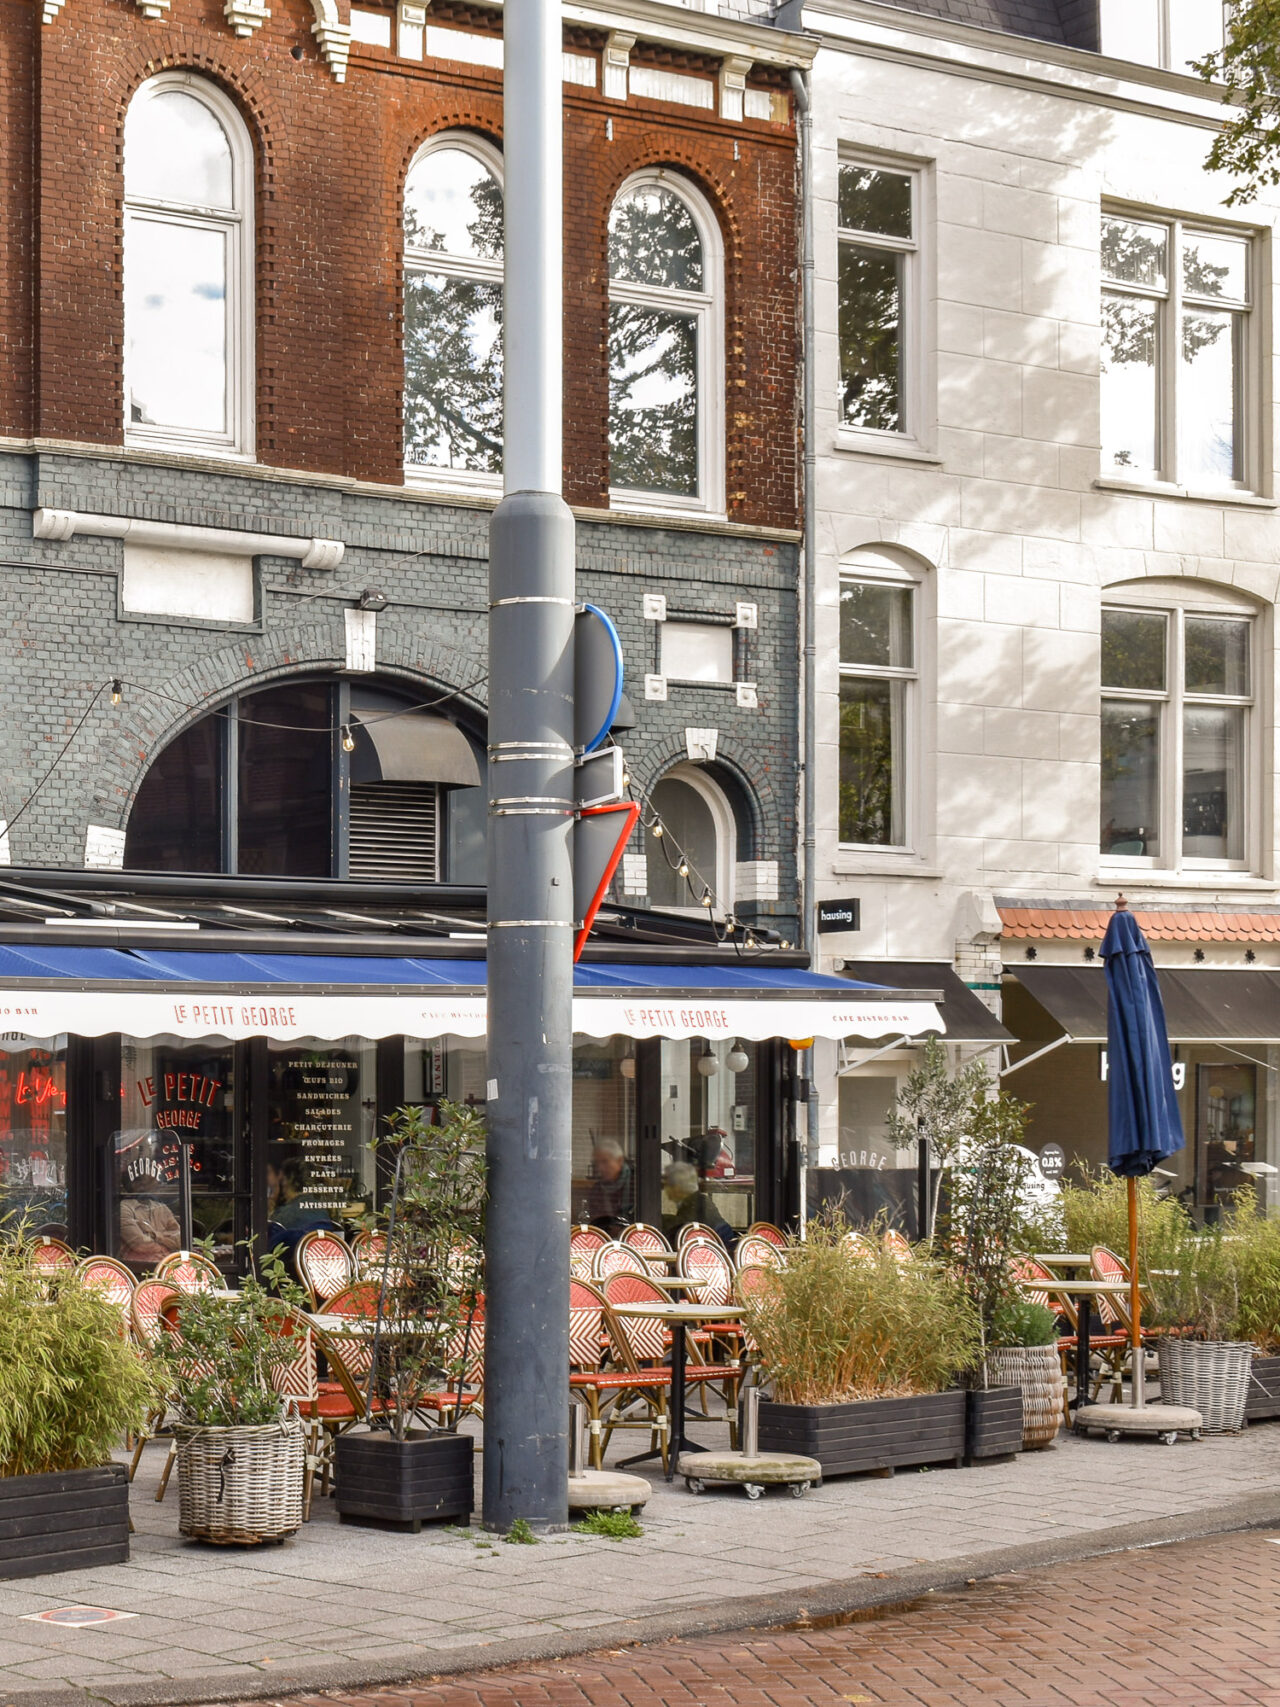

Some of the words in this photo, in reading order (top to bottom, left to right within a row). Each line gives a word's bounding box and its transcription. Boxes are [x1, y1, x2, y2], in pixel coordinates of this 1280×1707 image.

[821, 909, 853, 922] hausing
[174, 1005, 187, 1024] LE
[193, 1005, 233, 1025] PETIT
[241, 1007, 297, 1026] GEORGE
[624, 1009, 636, 1026] LE
[640, 1009, 676, 1027] PETIT
[680, 1010, 729, 1028] GEORGE
[288, 1061, 313, 1069] PETIT
[136, 1076, 157, 1109] LE
[164, 1072, 222, 1108] PETIT
[296, 1092, 350, 1100] SANDWICHES
[305, 1108, 342, 1116] SALADES
[156, 1109, 202, 1130] GEORGE
[301, 1139, 345, 1147] FROMAGES
[831, 1150, 887, 1172] GEORGE
[1041, 1156, 1063, 1168] 0.8%
[127, 1157, 162, 1182] GEORGE
[310, 1170, 336, 1178] PLATS
